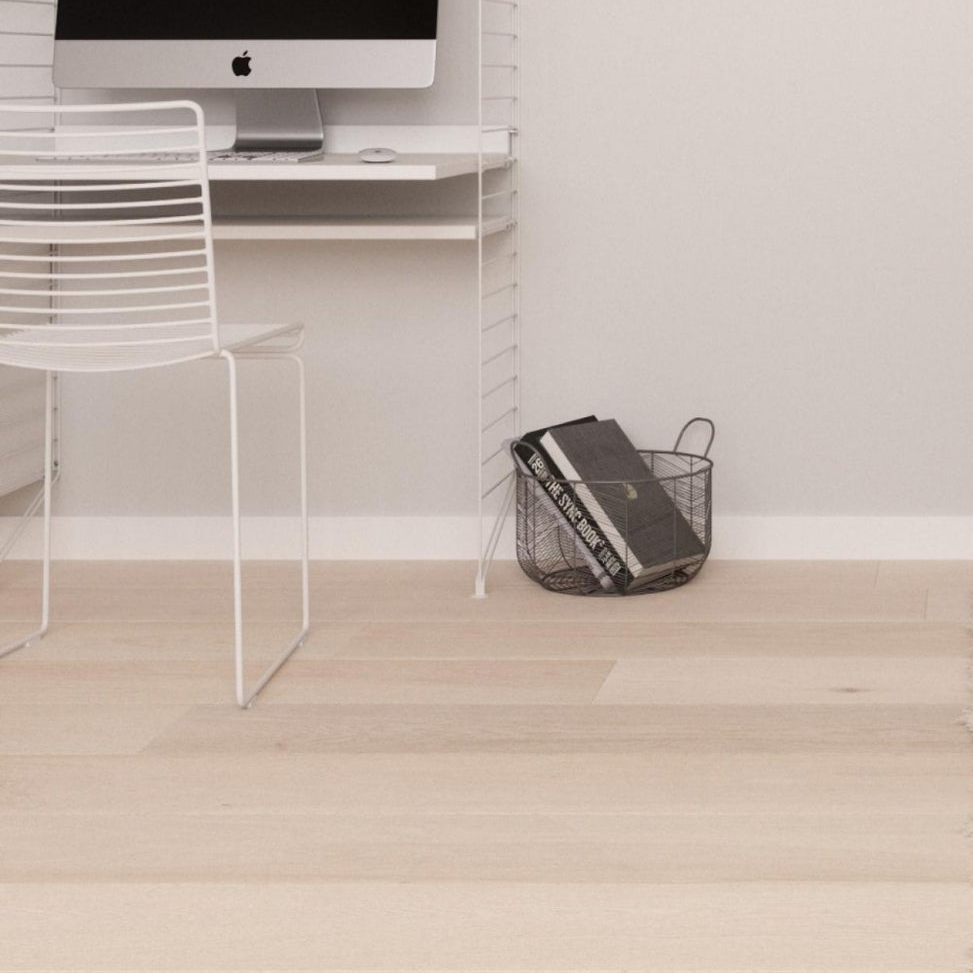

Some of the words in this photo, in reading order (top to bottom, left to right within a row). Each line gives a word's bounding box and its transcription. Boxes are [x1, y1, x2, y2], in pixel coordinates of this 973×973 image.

[545, 475, 563, 500] THE
[558, 493, 582, 523] SYNC
[576, 518, 601, 549] BOOK
